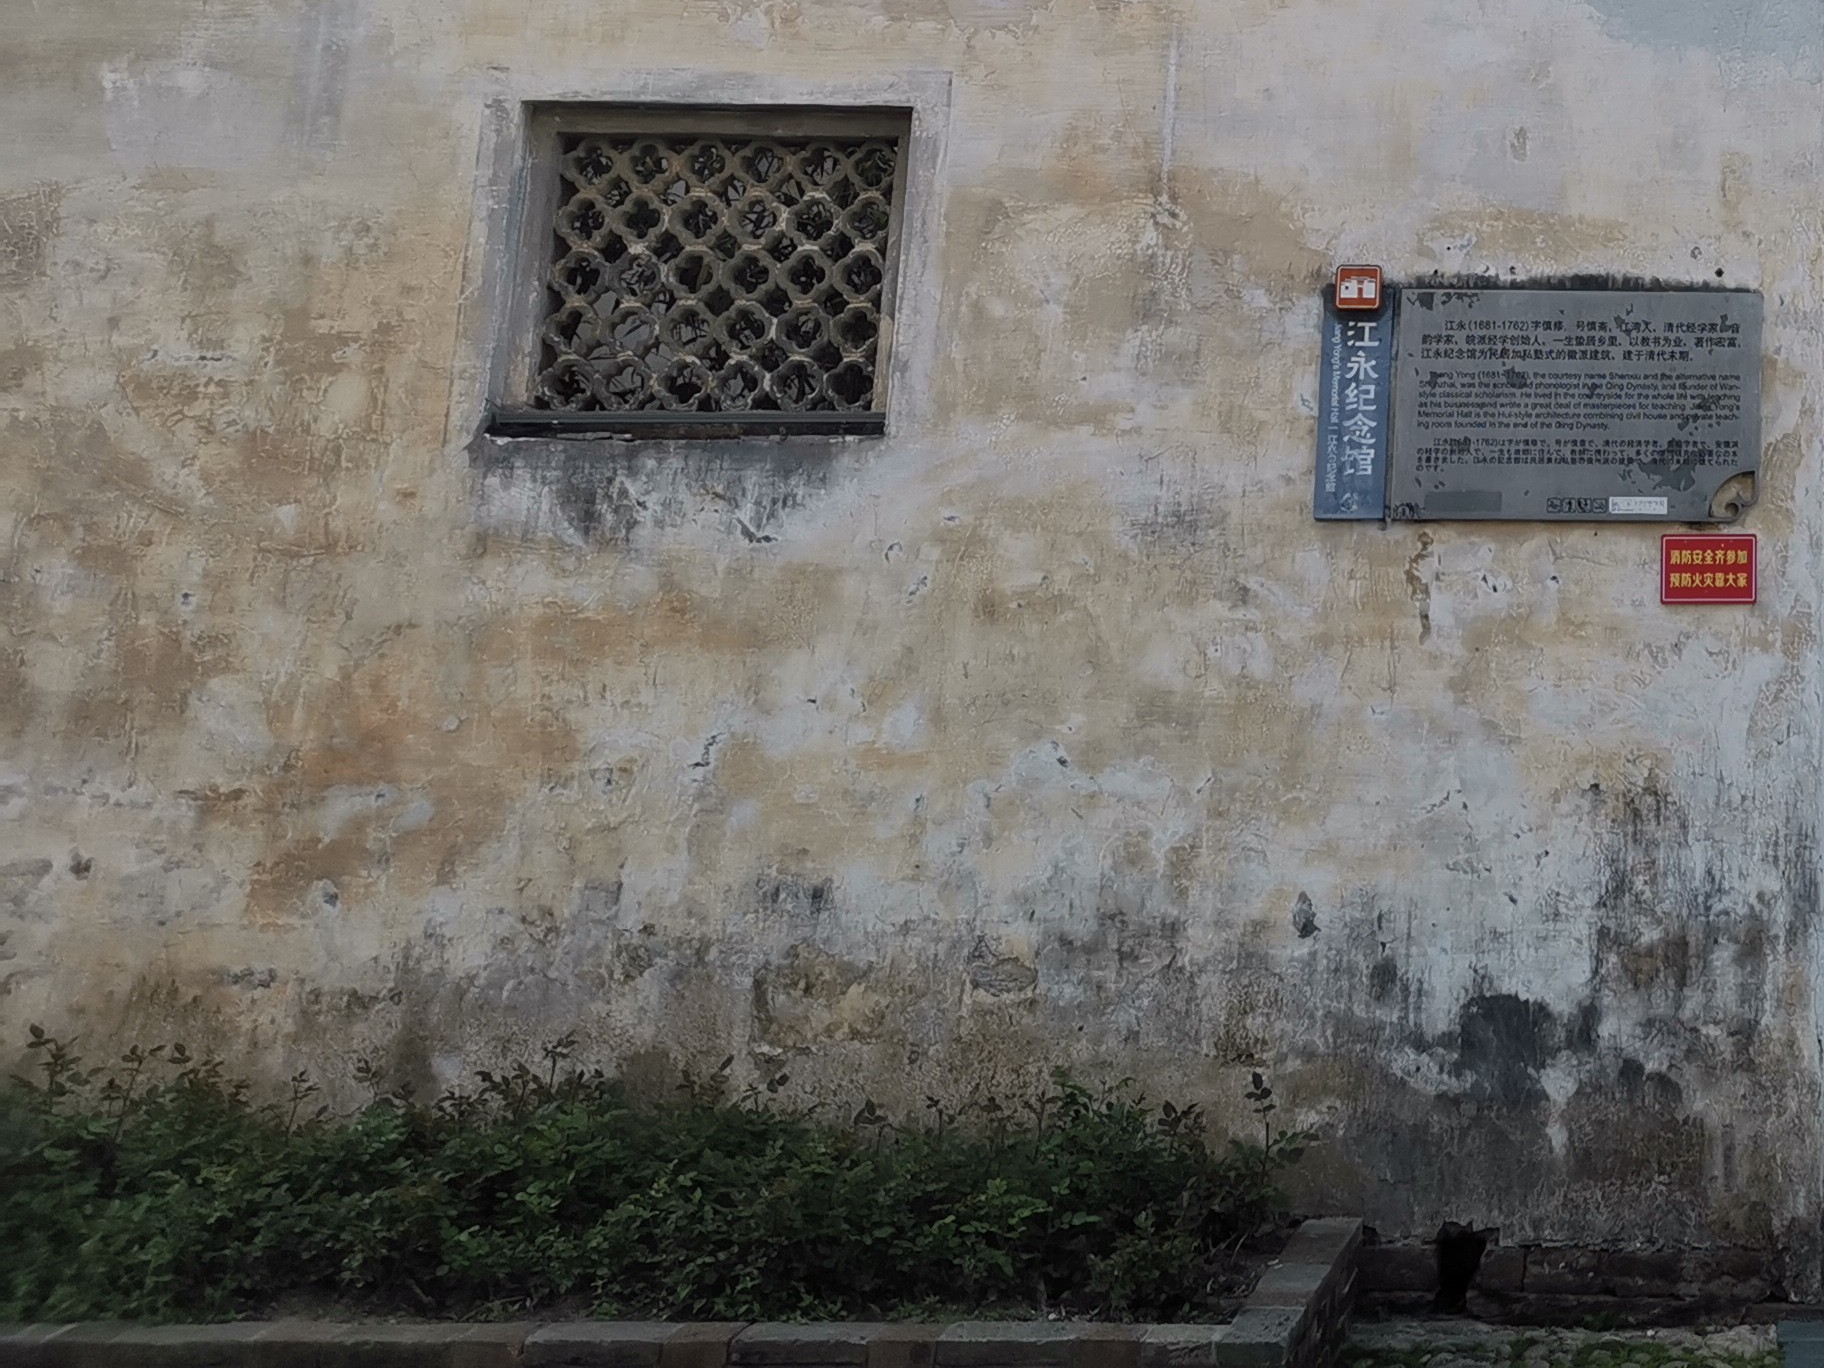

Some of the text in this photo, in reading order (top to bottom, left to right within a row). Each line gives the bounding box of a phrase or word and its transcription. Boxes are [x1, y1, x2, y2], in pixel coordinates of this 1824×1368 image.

[1455, 371, 1476, 381] Yong
[1533, 372, 1546, 380] the
[1548, 372, 1582, 382] courtesy
[1675, 373, 1716, 381] alternative
[1330, 371, 1341, 406] Memorial
[1478, 381, 1490, 389] the
[1535, 381, 1580, 391] phonologist
[1605, 382, 1624, 392] Qing
[1341, 320, 1380, 477] 江永纪念馆
[1439, 391, 1472, 399] classical
[1520, 391, 1532, 399] He
[1534, 391, 1552, 400] lived
[1563, 392, 1576, 400] the
[1625, 392, 1635, 400] for
[1637, 392, 1650, 400] the
[1652, 392, 1674, 400] whole
[1499, 401, 1522, 409] wrote
[1531, 402, 1552, 410] great
[1554, 401, 1571, 409] deal
[1573, 401, 1581, 409] of
[1583, 402, 1637, 411] masterpieces
[1639, 402, 1650, 410] for
[1417, 410, 1454, 418] Memorial
[1456, 410, 1473, 418] Hall
[1483, 410, 1496, 418] the
[1498, 410, 1533, 420] Hui-style
[1535, 411, 1582, 419] architecture
[1583, 412, 1624, 421] combining
[1626, 412, 1641, 420] civil
[1643, 412, 1667, 420] house
[1416, 420, 1430, 430] ing
[1454, 420, 1487, 428] founded
[1498, 420, 1511, 428] the
[1530, 420, 1538, 429] of
[1540, 420, 1552, 429] the
[1555, 420, 1574, 431] Qing
[1670, 549, 1748, 565] 消防安全齐参加
[1670, 572, 1748, 588] 预防火灾靠大家
